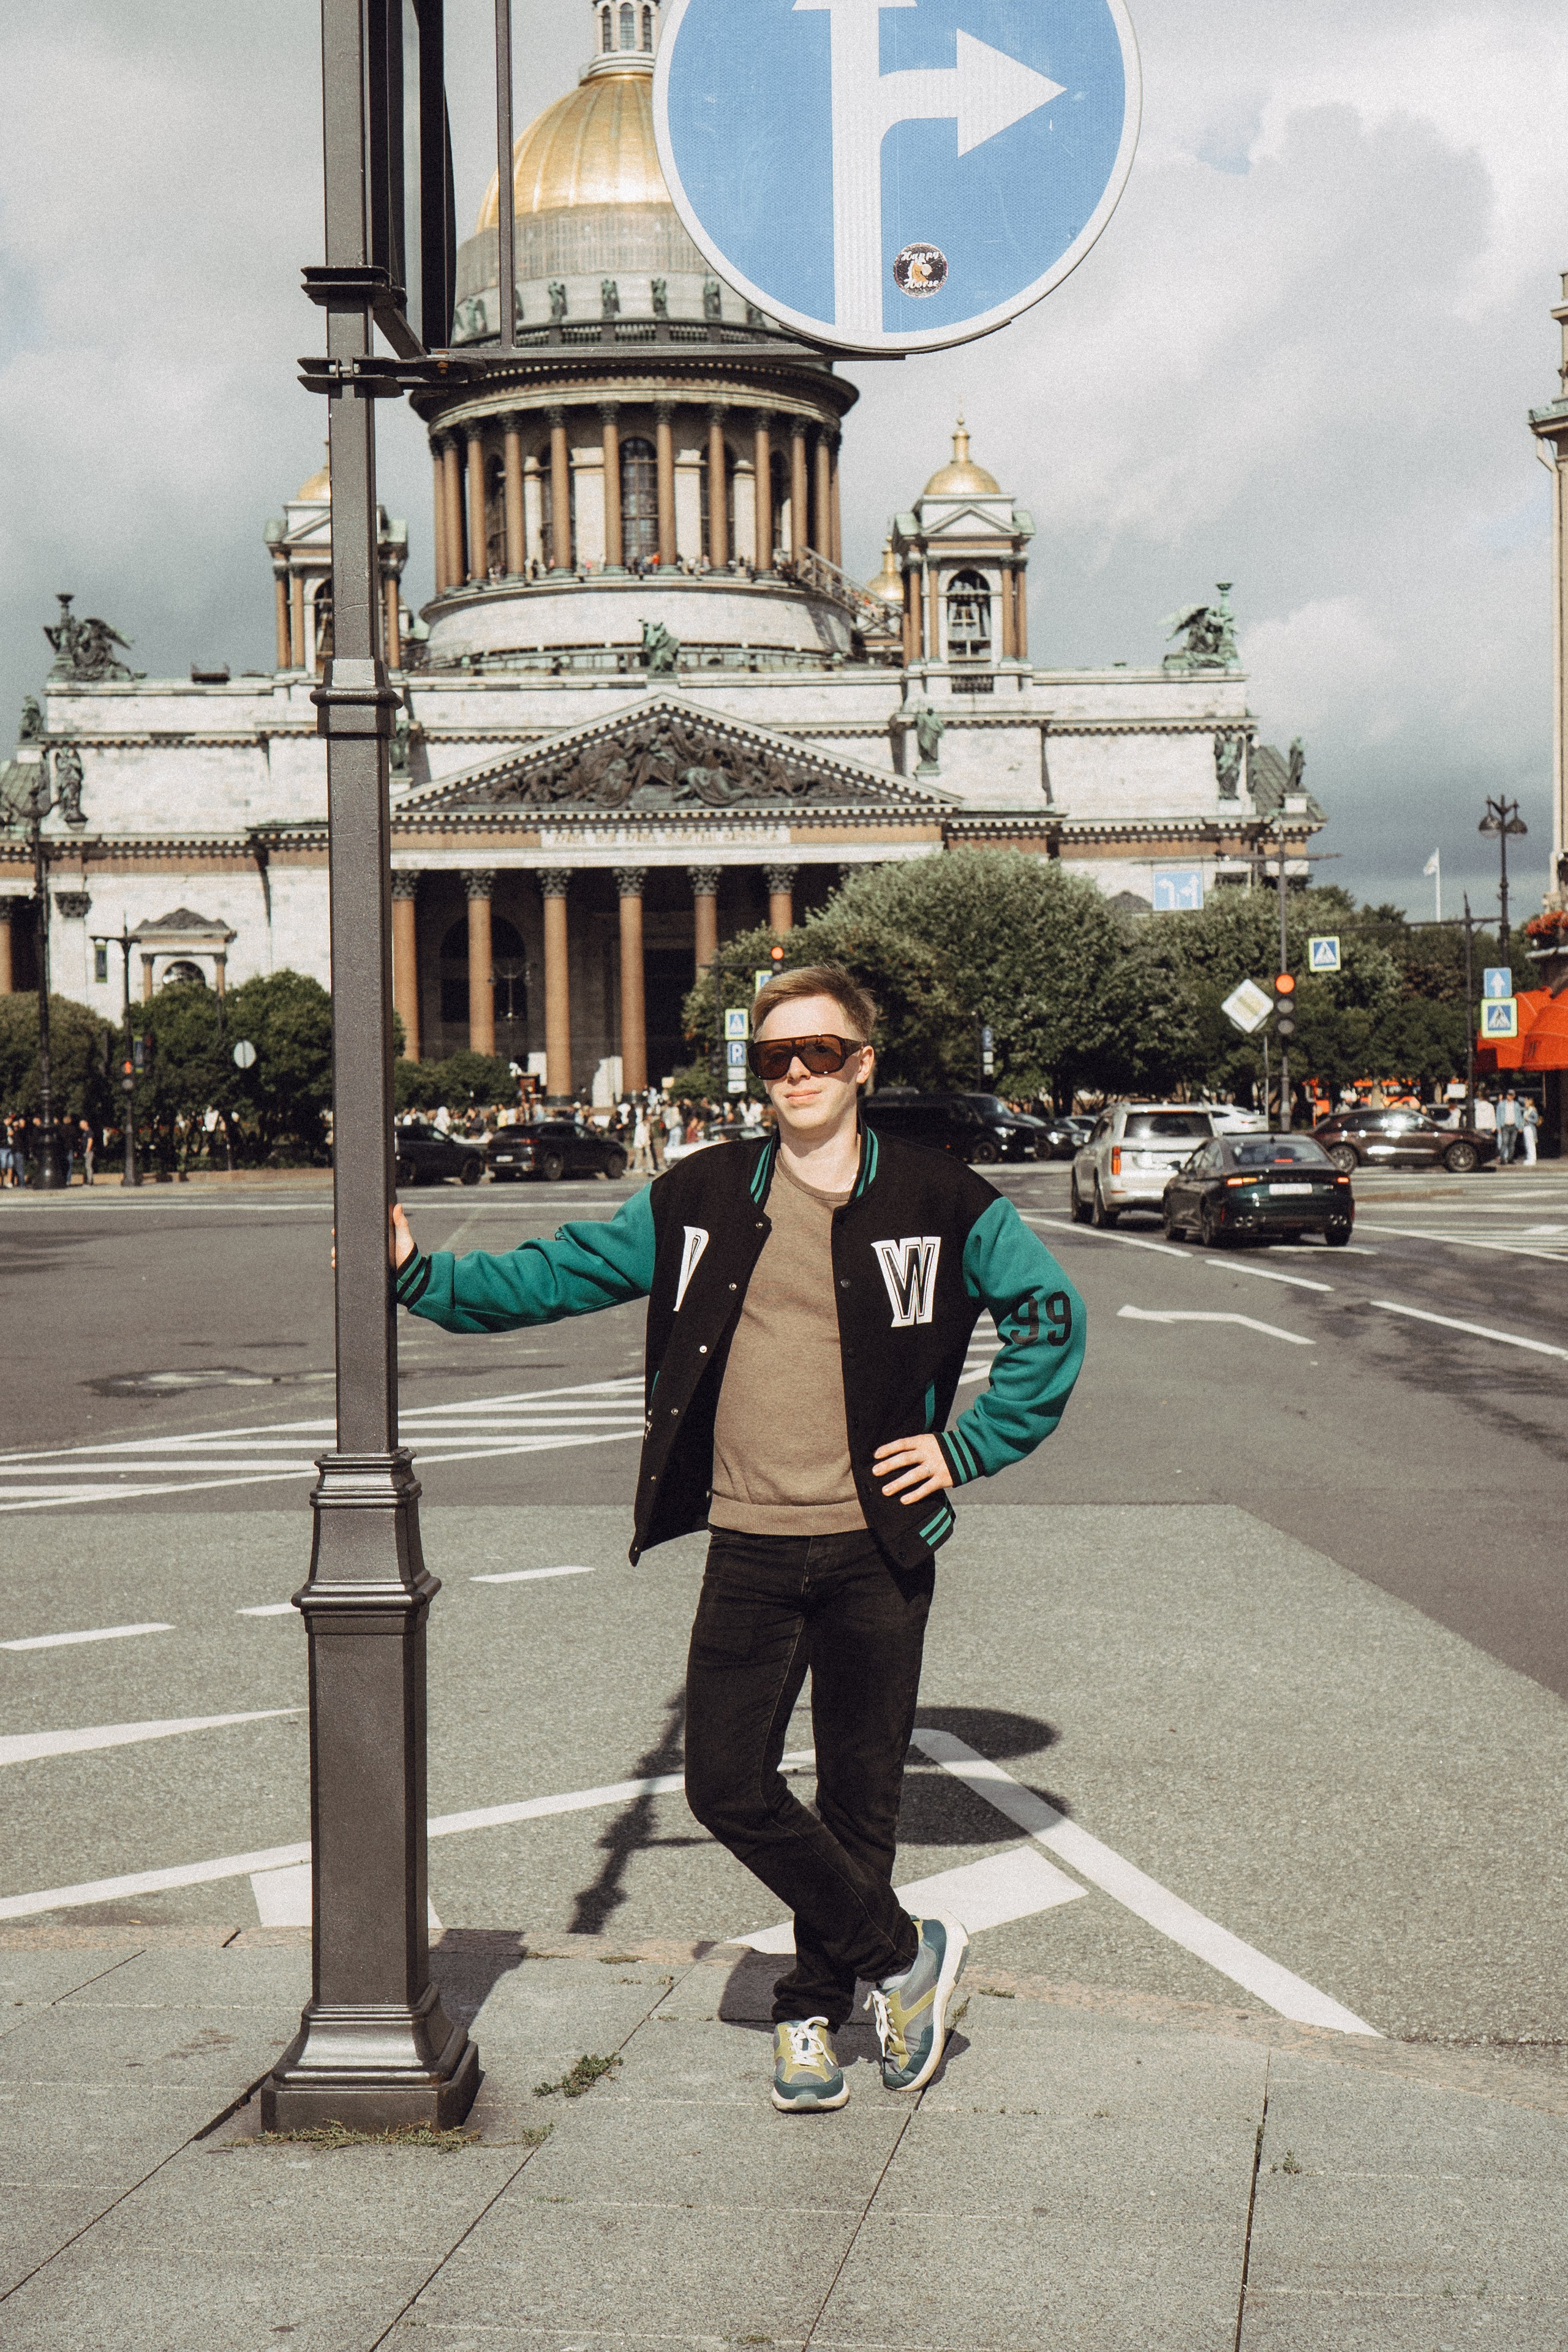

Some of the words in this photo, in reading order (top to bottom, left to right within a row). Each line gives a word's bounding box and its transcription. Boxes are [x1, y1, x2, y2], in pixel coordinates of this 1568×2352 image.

[900, 251, 940, 262] Happy
[871, 1236, 941, 1328] W
[1009, 1291, 1072, 1346] 99
